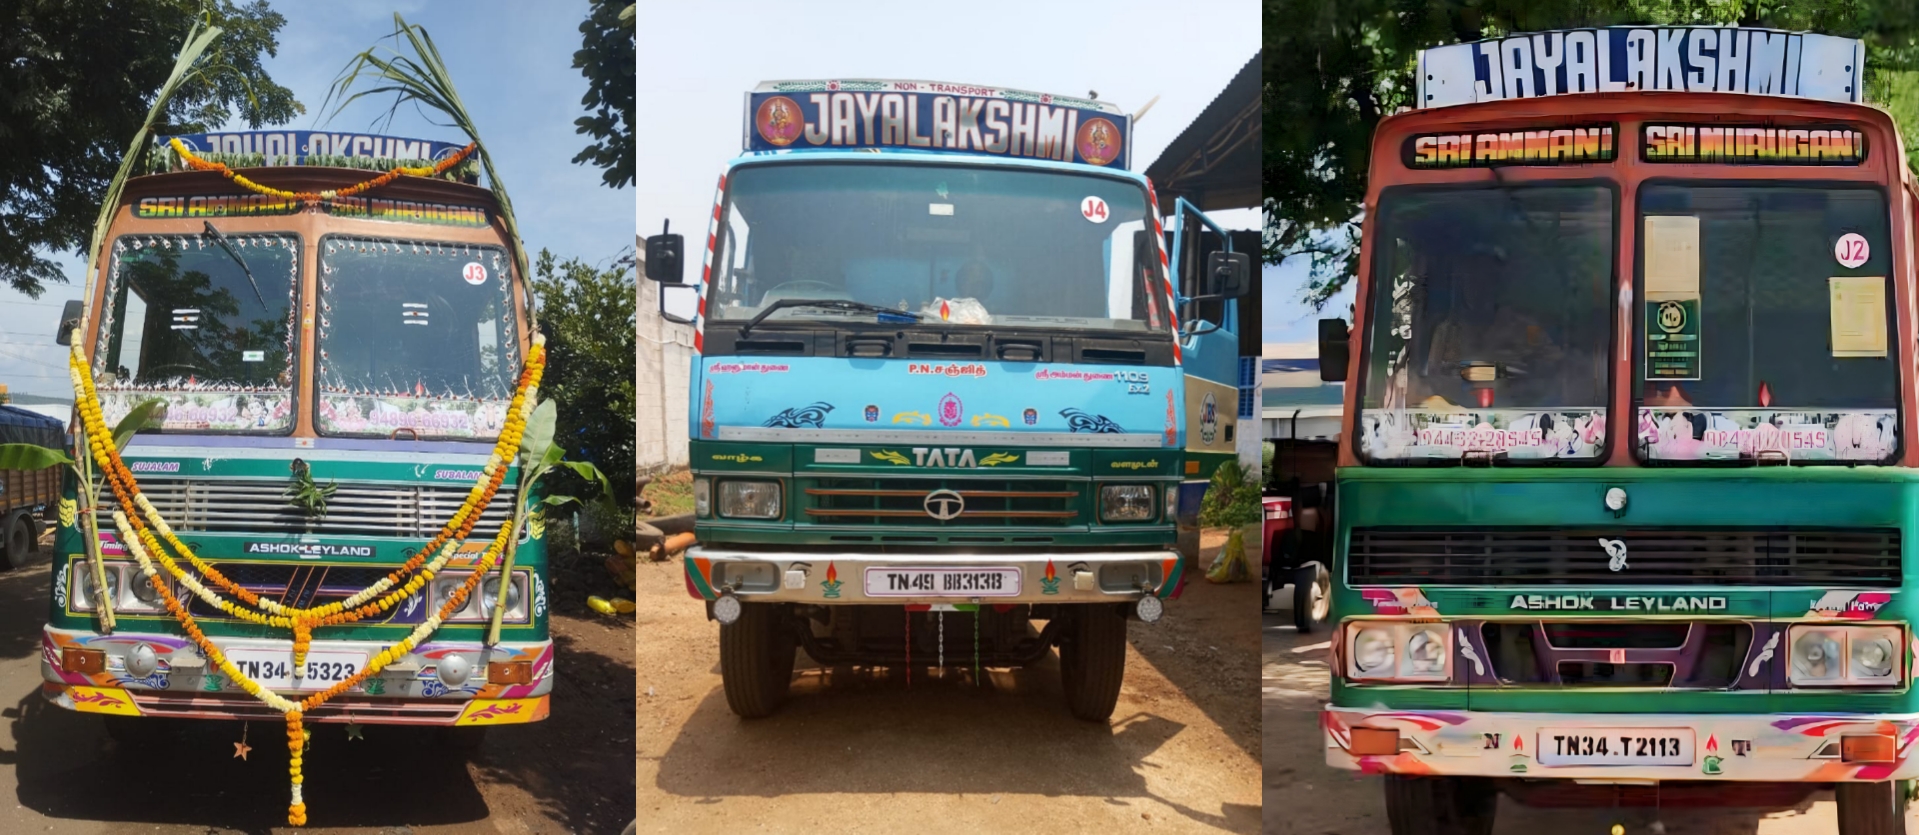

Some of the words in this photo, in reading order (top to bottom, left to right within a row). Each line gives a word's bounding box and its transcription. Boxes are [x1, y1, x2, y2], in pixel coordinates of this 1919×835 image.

[1473, 29, 1801, 97] JAYALAKSHMI
[929, 84, 995, 96] TRANSPORT
[805, 91, 1078, 163] JAYALAKSHMI
[139, 197, 185, 217] SRI
[1084, 200, 1106, 219] J4
[1841, 240, 1865, 261] J2
[465, 265, 485, 281] J3
[1114, 371, 1149, 383] 1109
[912, 447, 977, 468] TATA
[131, 461, 180, 472] SUJALAM
[250, 543, 299, 553] ASHOK
[304, 545, 371, 556] LEYLAND
[1510, 595, 1594, 610] ASHOK
[1612, 597, 1726, 610] LEYLAND
